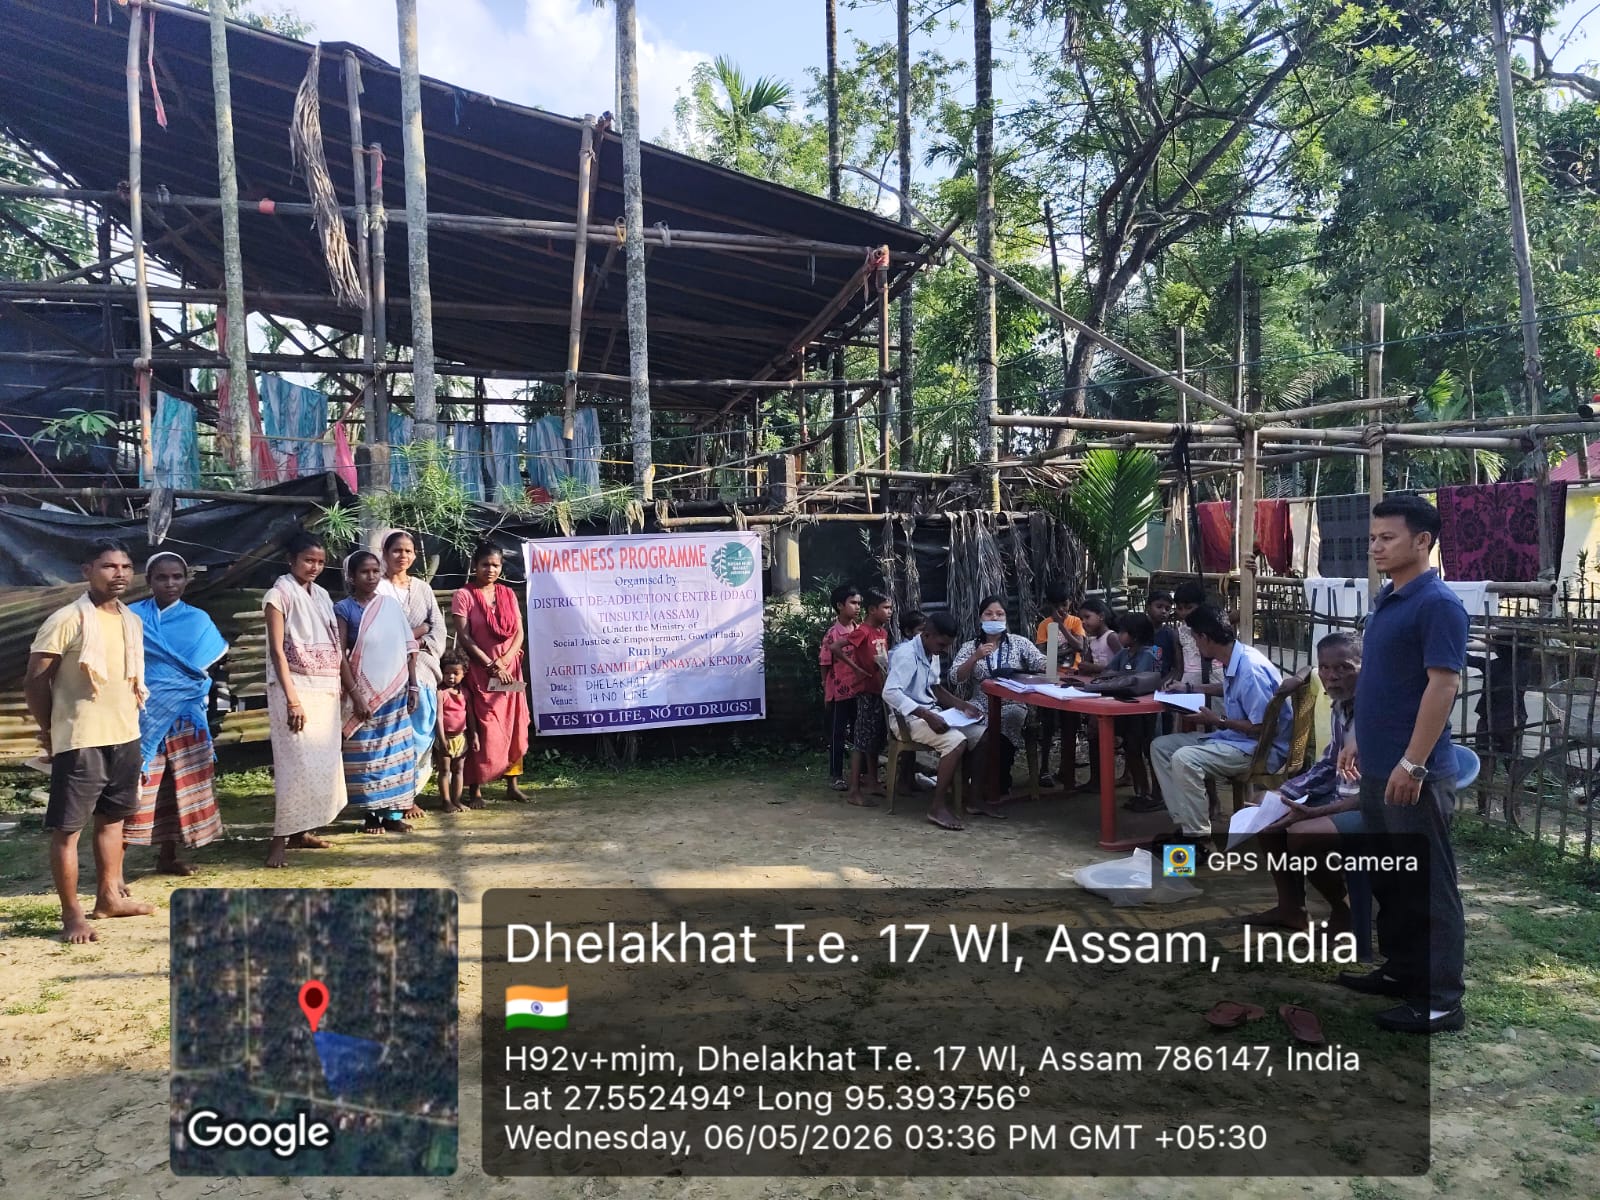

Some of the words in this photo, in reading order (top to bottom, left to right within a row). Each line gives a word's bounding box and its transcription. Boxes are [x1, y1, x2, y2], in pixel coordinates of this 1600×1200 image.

[531, 547, 615, 574] AWARENESS
[619, 544, 708, 570] PROGRAMME
[614, 573, 663, 588] Organised
[533, 596, 585, 609] DISTRICT
[588, 592, 671, 606] DE-ADDICTION
[674, 591, 718, 602] CENTRE
[720, 589, 757, 601] (DDAC)
[597, 610, 652, 622] TINSUKIA
[653, 608, 700, 620] (ASSAM)
[602, 624, 632, 634] (Under
[635, 624, 649, 632] the
[650, 622, 685, 633] Ministry
[687, 621, 697, 629] of
[553, 638, 578, 648] Social
[580, 637, 610, 647] Justice
[612, 636, 620, 644] &
[710, 631, 718, 640] of
[720, 630, 744, 639] India)
[628, 646, 651, 657] Run
[545, 664, 587, 677] JAGRITI
[590, 660, 651, 674] SANMILITA
[654, 658, 706, 670] UNNAYAN
[709, 654, 752, 667] KENDRA
[585, 676, 648, 691] DHELAKHAT
[602, 691, 617, 702] NO
[623, 688, 648, 701] LINE
[549, 713, 580, 726] YES
[582, 712, 604, 725] TO
[608, 709, 646, 723] LIFE,
[674, 705, 695, 717] TO
[699, 700, 753, 715] DRUGS!
